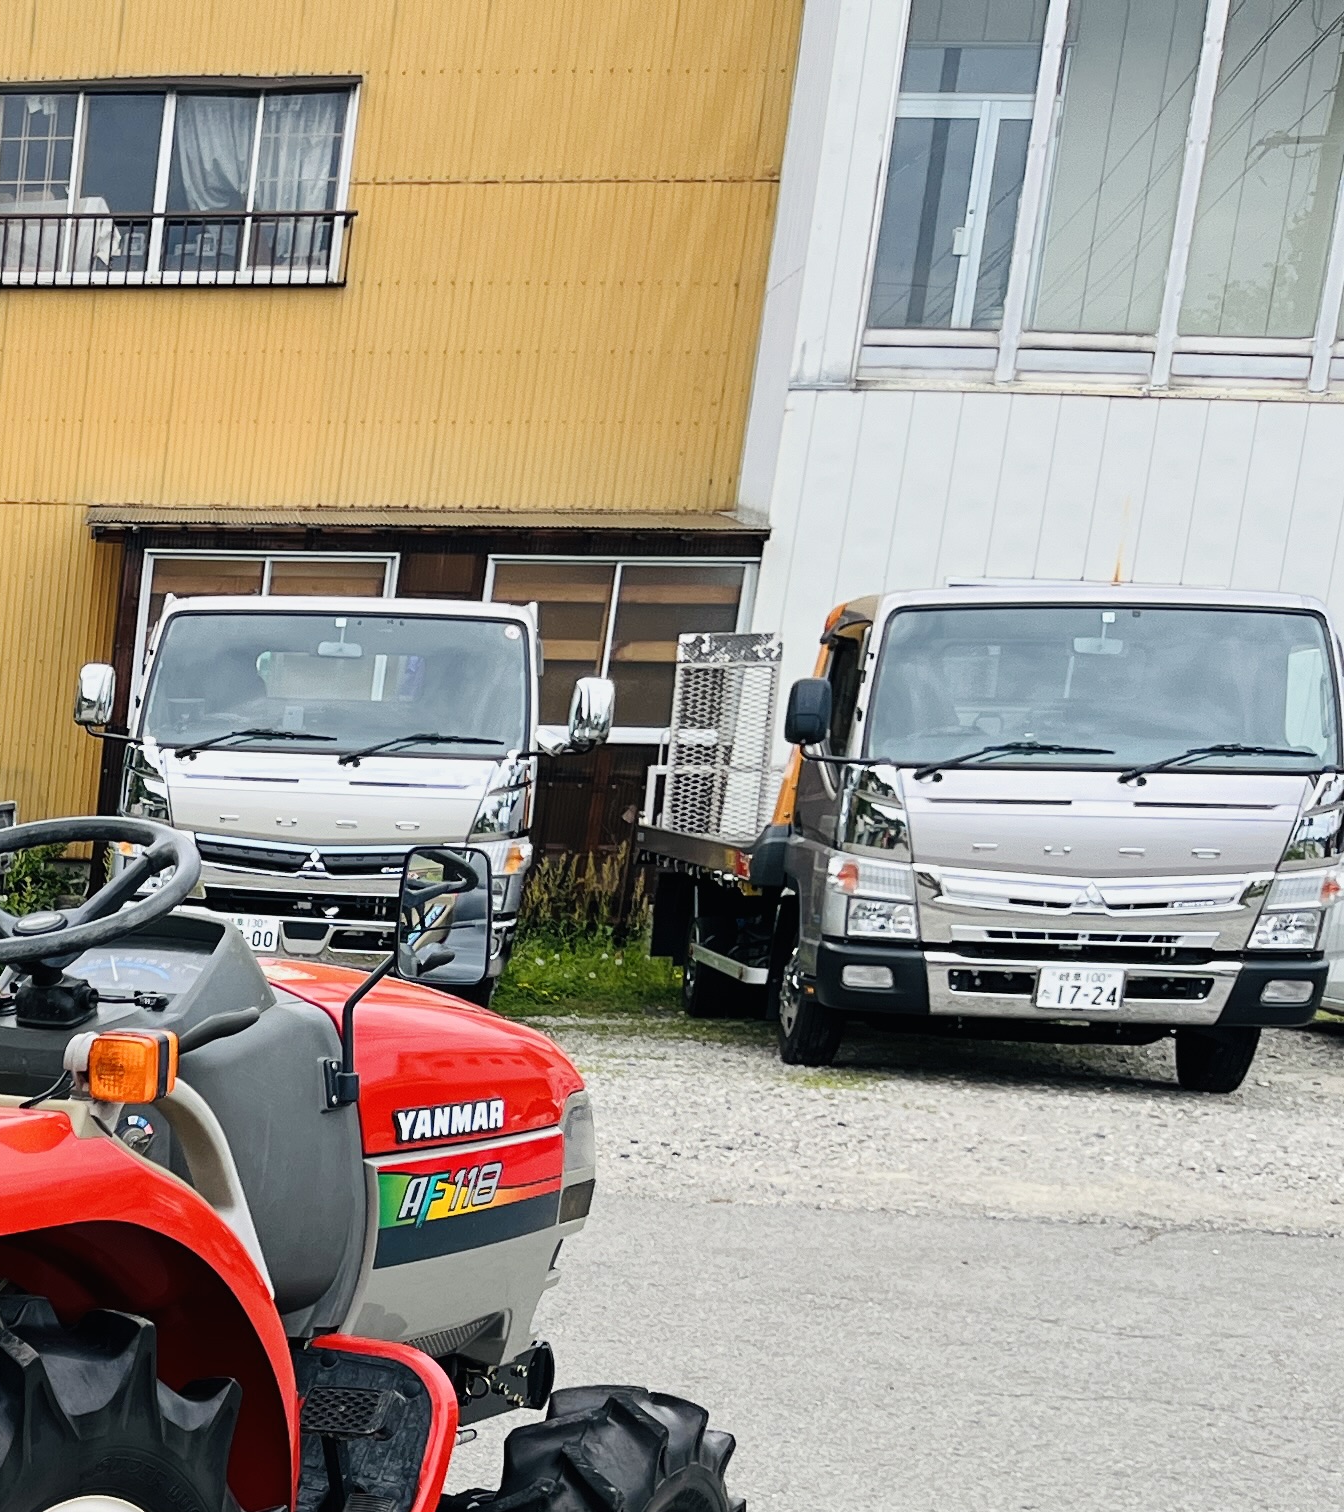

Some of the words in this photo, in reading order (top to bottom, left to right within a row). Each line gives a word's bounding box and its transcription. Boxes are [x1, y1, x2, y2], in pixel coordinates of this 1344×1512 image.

[239, 929, 273, 948] -00
[1057, 985, 1118, 1006] 17-24
[397, 1099, 505, 1142] YANMAR
[397, 1161, 504, 1229] AF118
